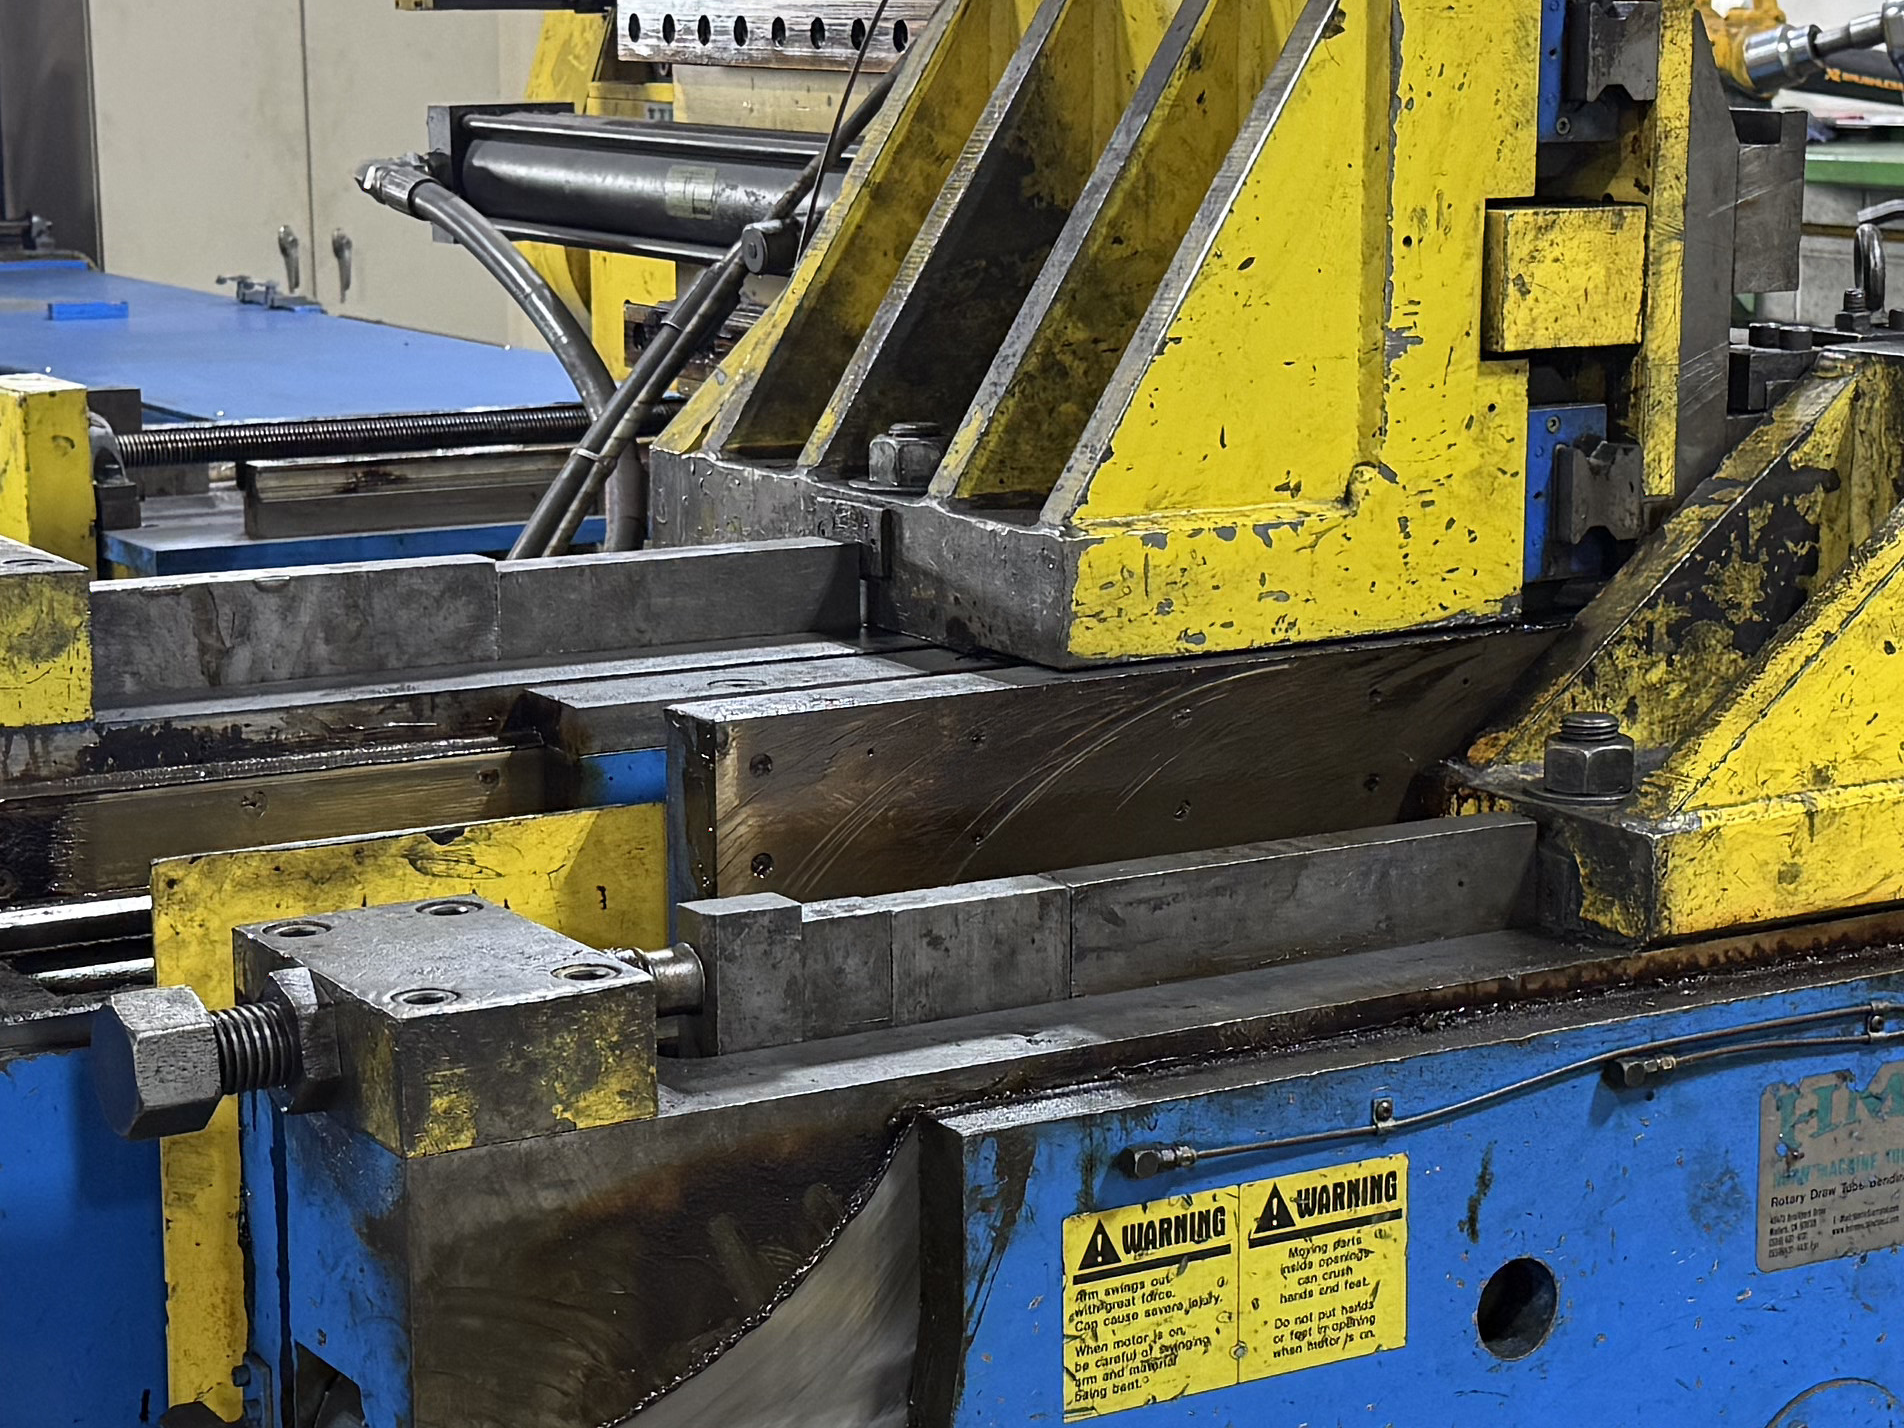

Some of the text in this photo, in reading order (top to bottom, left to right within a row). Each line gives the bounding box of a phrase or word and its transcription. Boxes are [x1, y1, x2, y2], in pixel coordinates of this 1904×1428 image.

[1297, 1170, 1397, 1219] WARNING
[1770, 1194, 1806, 1208] Rotary
[1810, 1186, 1837, 1200] Draw
[1122, 1205, 1226, 1255] WARNING
[1288, 1236, 1362, 1259] Moving parts
[1280, 1260, 1313, 1276] inside
[1297, 1266, 1353, 1286] can crush
[1075, 1289, 1098, 1303] Arm
[1104, 1282, 1145, 1297] swings
[1280, 1288, 1314, 1304] hands
[1319, 1281, 1339, 1296] and
[1105, 1296, 1136, 1314] great
[1274, 1300, 1374, 1329] Do not put hands
[1075, 1320, 1098, 1333] Can
[1103, 1312, 1139, 1326] cause
[1144, 1302, 1184, 1318] severe
[1075, 1341, 1108, 1358] When
[1113, 1333, 1149, 1350] motor
[1153, 1329, 1163, 1343] is
[1273, 1334, 1284, 1344] or
[1075, 1360, 1089, 1373] be
[1095, 1349, 1137, 1369] careful
[1159, 1336, 1211, 1355] swinging
[1273, 1344, 1302, 1358] when
[1075, 1376, 1097, 1388] arm
[1102, 1367, 1125, 1382] and
[1075, 1379, 1142, 1403] being bent.
